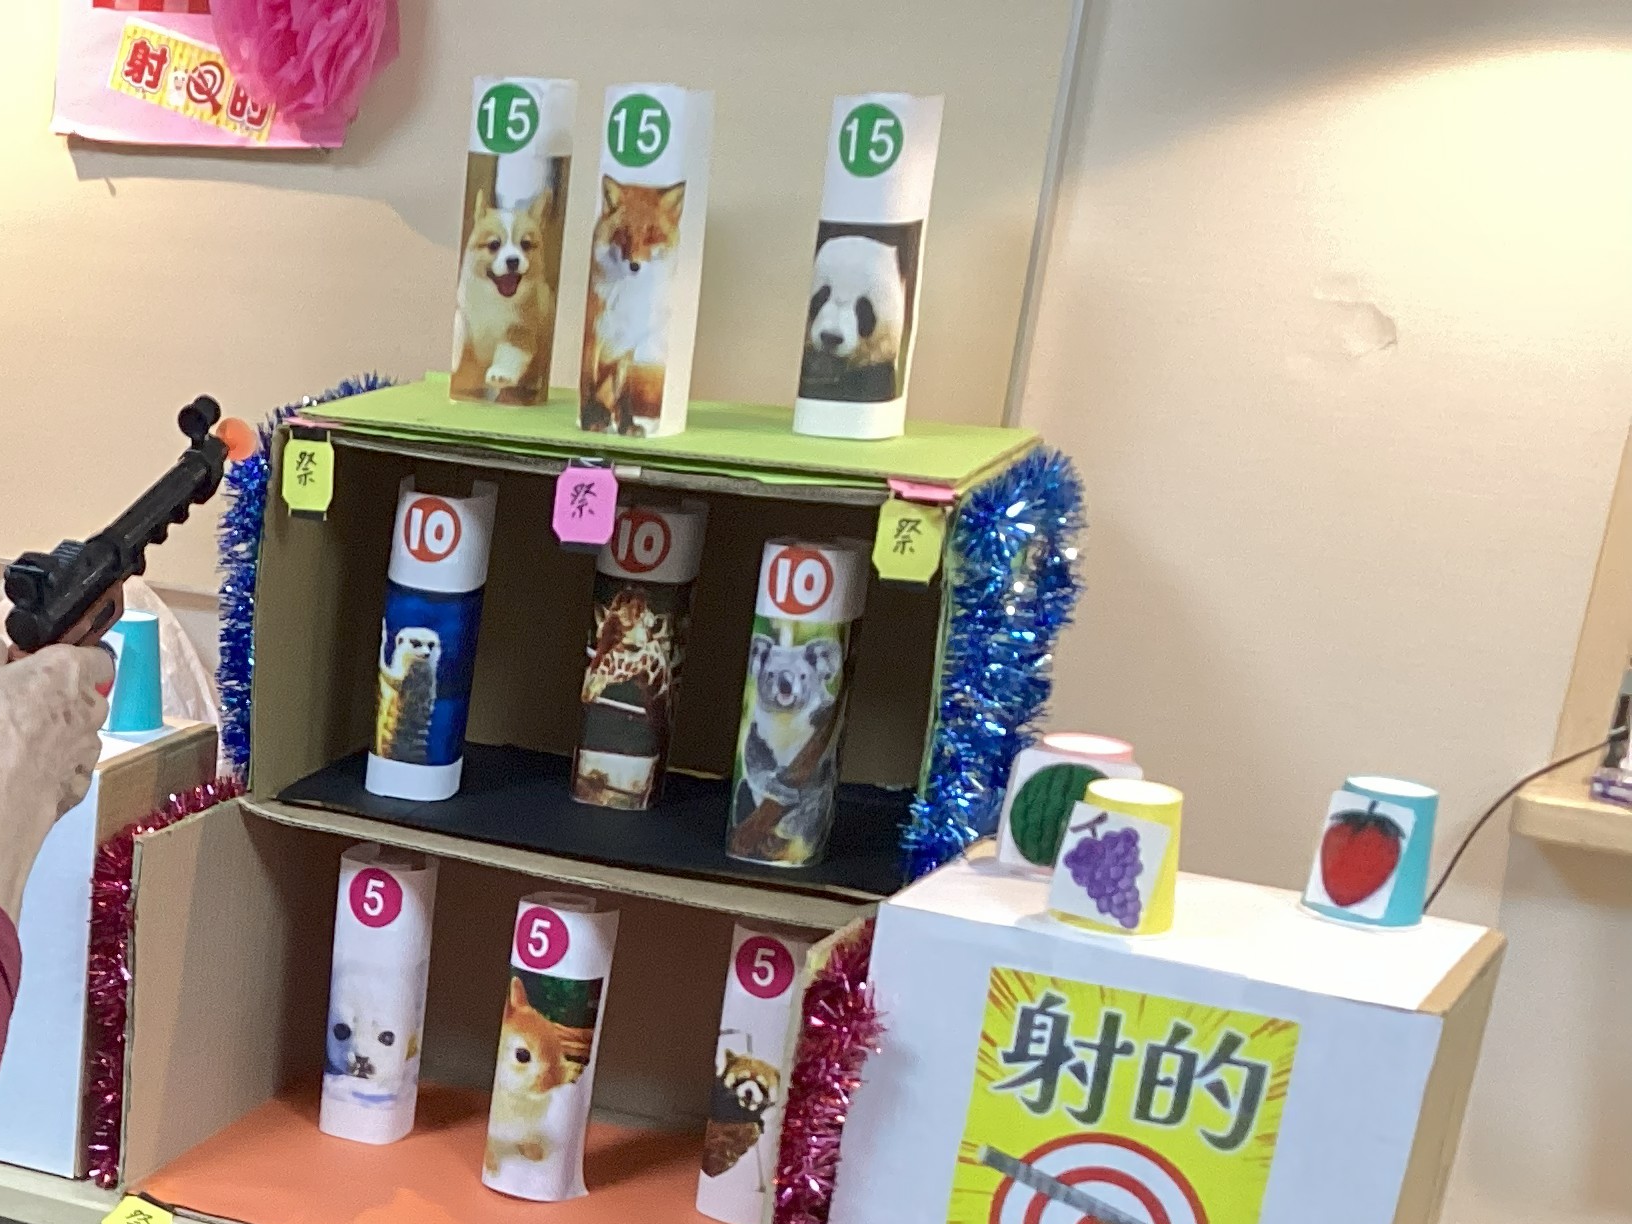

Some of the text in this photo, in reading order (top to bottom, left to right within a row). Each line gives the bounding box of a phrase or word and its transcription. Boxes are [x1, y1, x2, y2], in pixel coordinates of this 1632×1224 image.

[479, 96, 533, 141] 15
[612, 107, 663, 154] 15
[845, 117, 896, 164] 15
[295, 450, 317, 487] 祭
[570, 482, 598, 518] 祭
[409, 507, 456, 554] 10
[617, 519, 665, 566] 10
[892, 517, 924, 555] 祭
[775, 557, 828, 607] 10
[363, 877, 386, 918] 5
[527, 918, 551, 958] 5
[750, 948, 777, 987] 5
[991, 990, 1269, 1152] 射的
